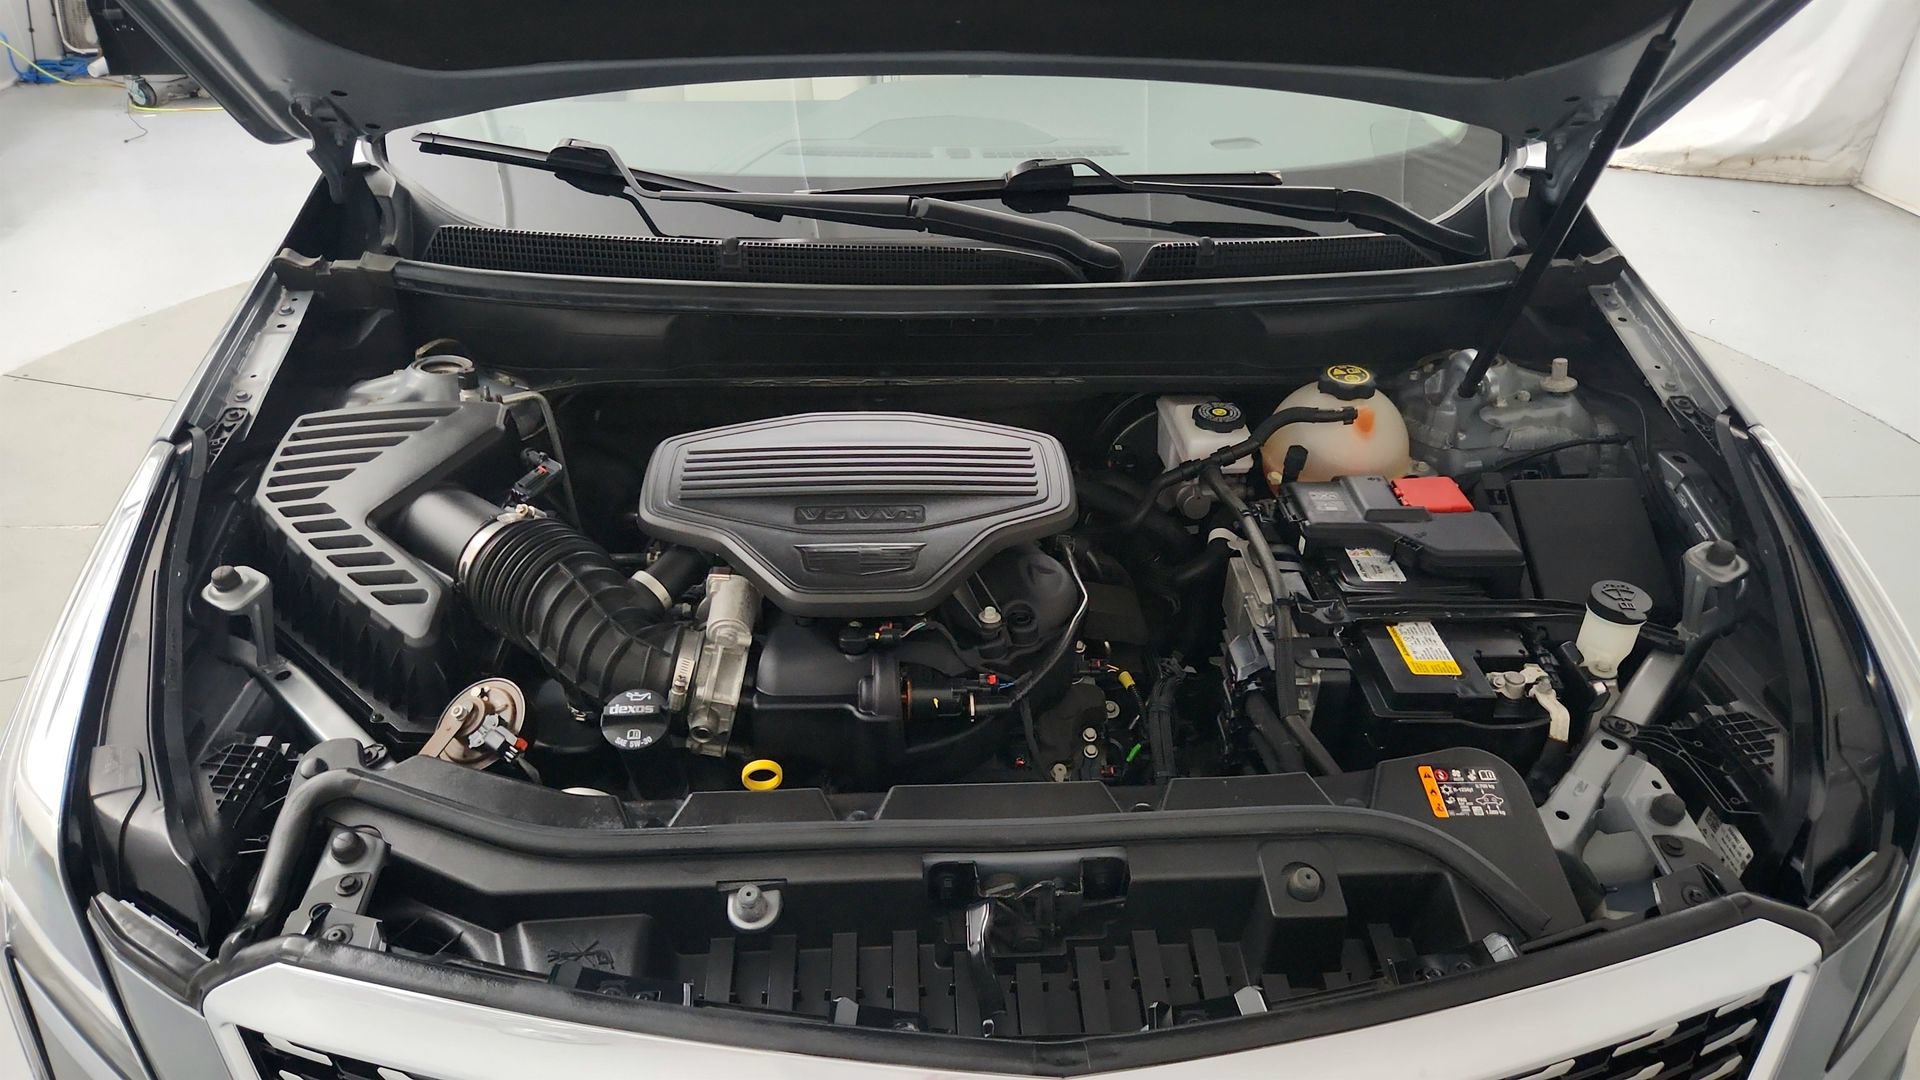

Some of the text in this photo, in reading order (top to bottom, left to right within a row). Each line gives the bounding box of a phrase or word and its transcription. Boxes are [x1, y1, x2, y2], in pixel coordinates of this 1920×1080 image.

[609, 704, 655, 715] dexos
[614, 736, 653, 748] SAE 5W-30
